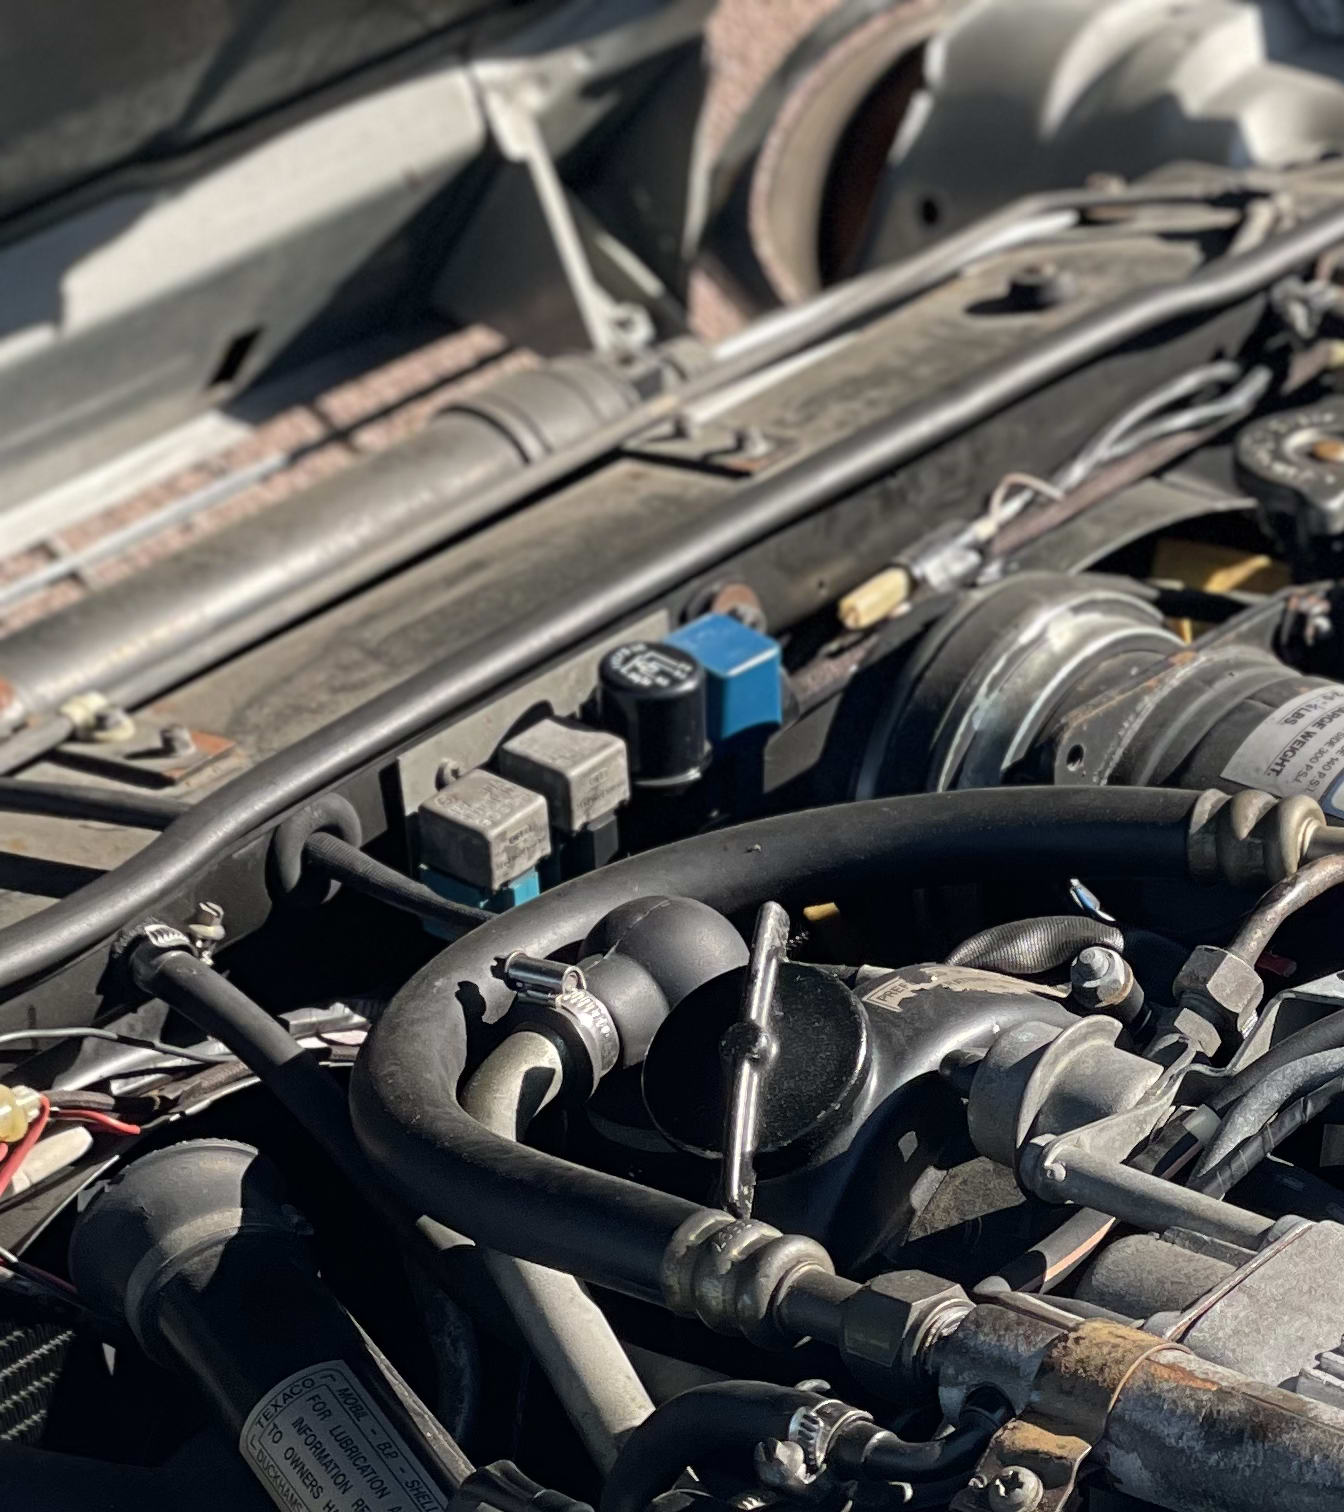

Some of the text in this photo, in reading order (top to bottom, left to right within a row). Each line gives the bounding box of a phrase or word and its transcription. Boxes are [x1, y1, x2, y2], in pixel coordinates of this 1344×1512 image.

[1264, 729, 1317, 778] WEIGHT.
[255, 1379, 315, 1429] TEXACO
[266, 1423, 283, 1444] TO
[284, 1447, 323, 1499] OWNERS
[292, 1416, 352, 1494] INFORMATION
[307, 1394, 331, 1422] FOR
[329, 1424, 390, 1499] LUBRICATION
